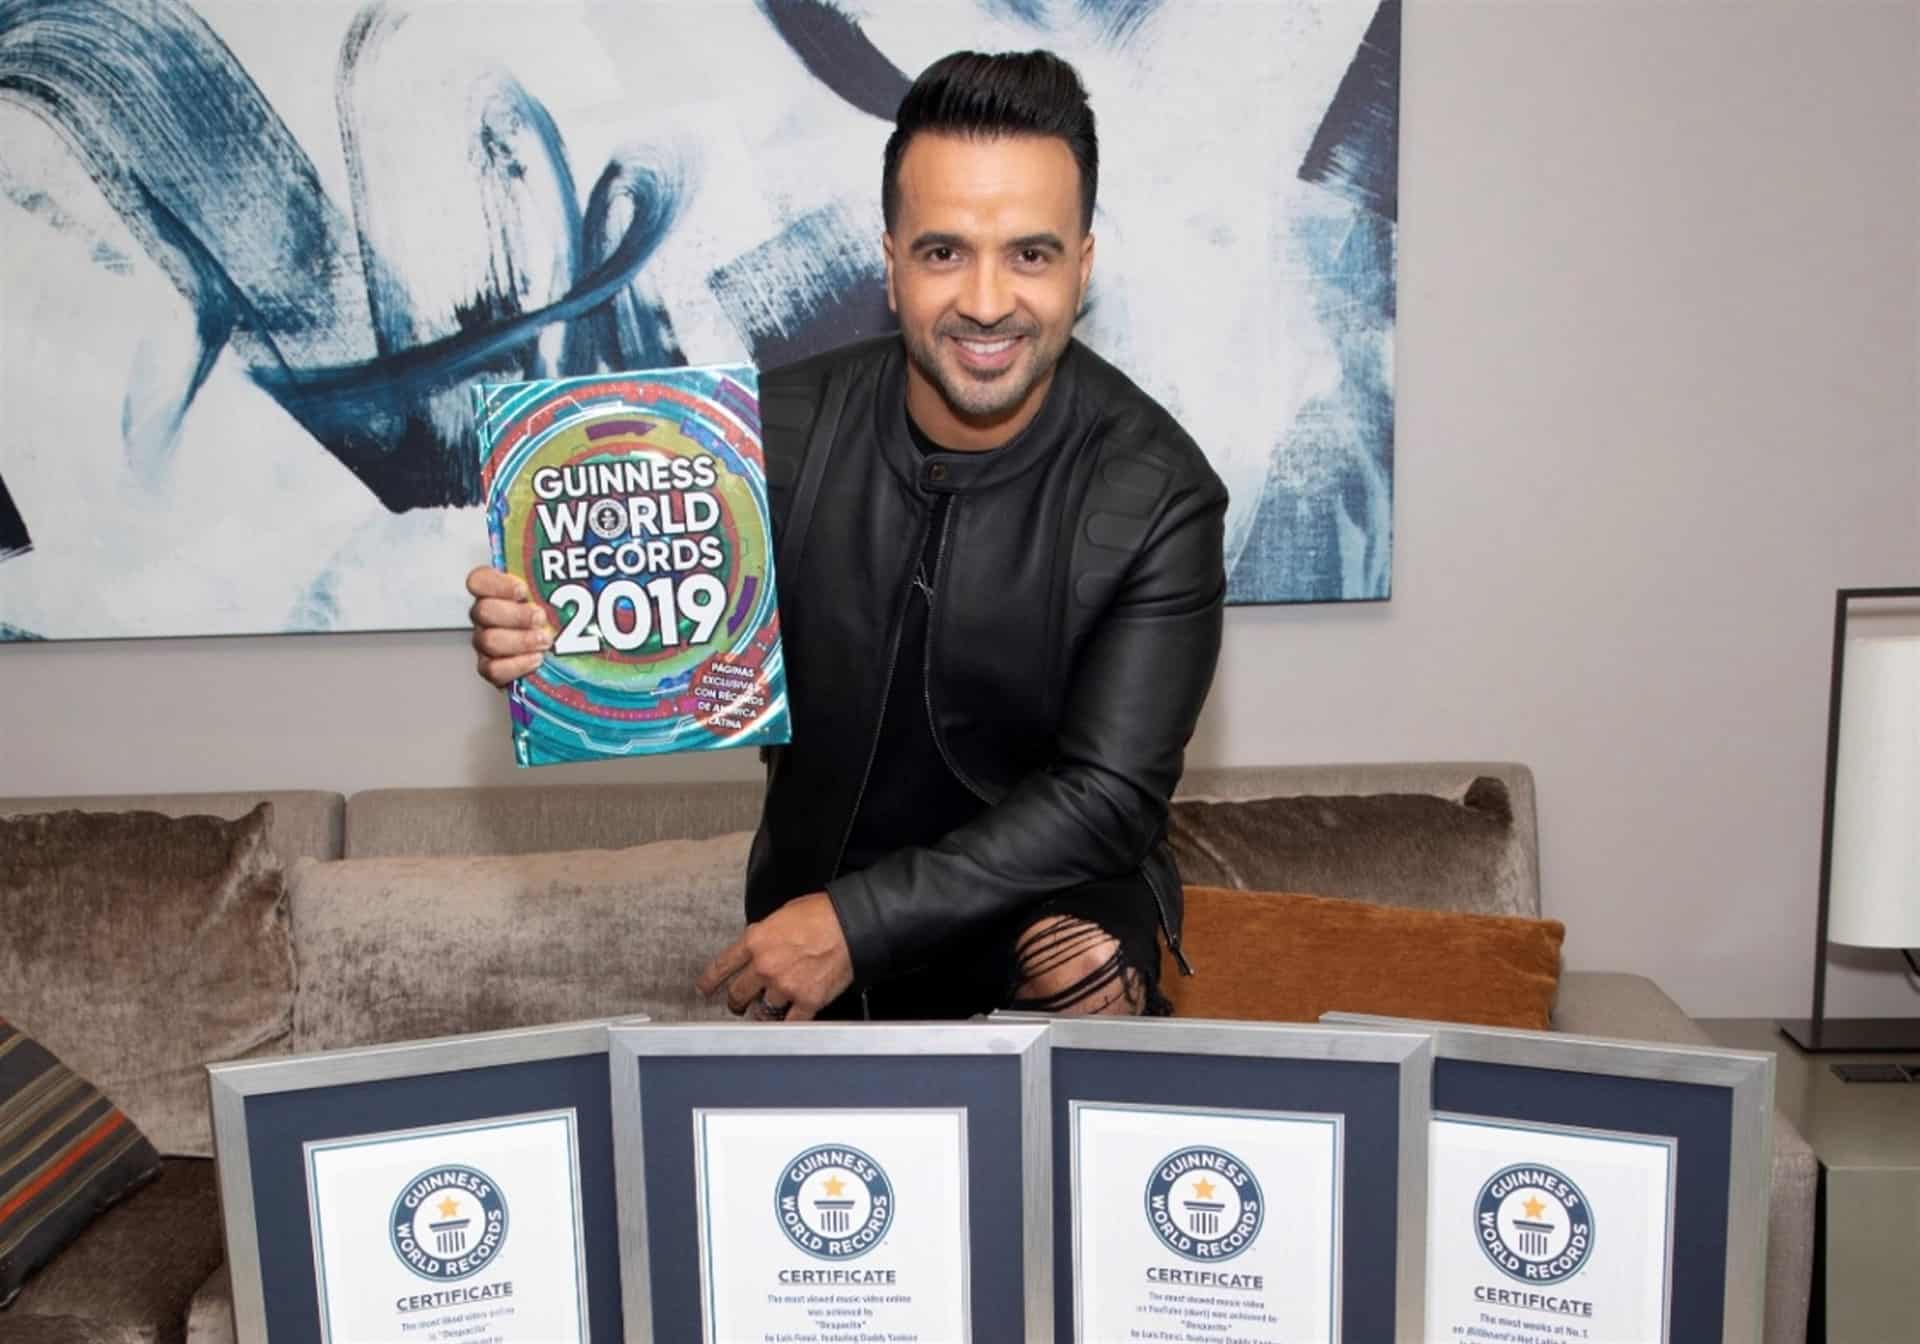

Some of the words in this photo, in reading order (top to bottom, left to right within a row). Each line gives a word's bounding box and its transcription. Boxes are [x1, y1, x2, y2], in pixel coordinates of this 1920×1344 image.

[533, 455, 717, 500] GUINNESS
[535, 492, 720, 543] WORLD
[541, 537, 723, 580] RECORDS
[549, 574, 727, 654] 2019
[695, 687, 716, 699] CON
[703, 675, 759, 692] EXCLUSIVA
[698, 701, 711, 712] DE
[791, 1151, 876, 1183] GUINNESS
[1161, 1153, 1248, 1187] GUINNESS
[404, 1171, 491, 1209] GUINNESS
[1491, 1171, 1579, 1208] GUINNESS
[396, 1221, 440, 1275] WORLD
[445, 1209, 502, 1276] RECORDS
[781, 1196, 822, 1250] WORLD
[829, 1195, 888, 1255] RECORDS
[1151, 1195, 1191, 1251] WORLD
[1197, 1200, 1257, 1257] RECORDS
[1480, 1211, 1519, 1270] WORLD
[1525, 1224, 1587, 1279] RECORDS
[778, 1270, 896, 1283] CERTIFICATE
[1146, 1267, 1264, 1289] CERTIFICATE
[396, 1281, 513, 1311] CERTIFICATE
[1474, 1286, 1592, 1315] CERTIFICATE
